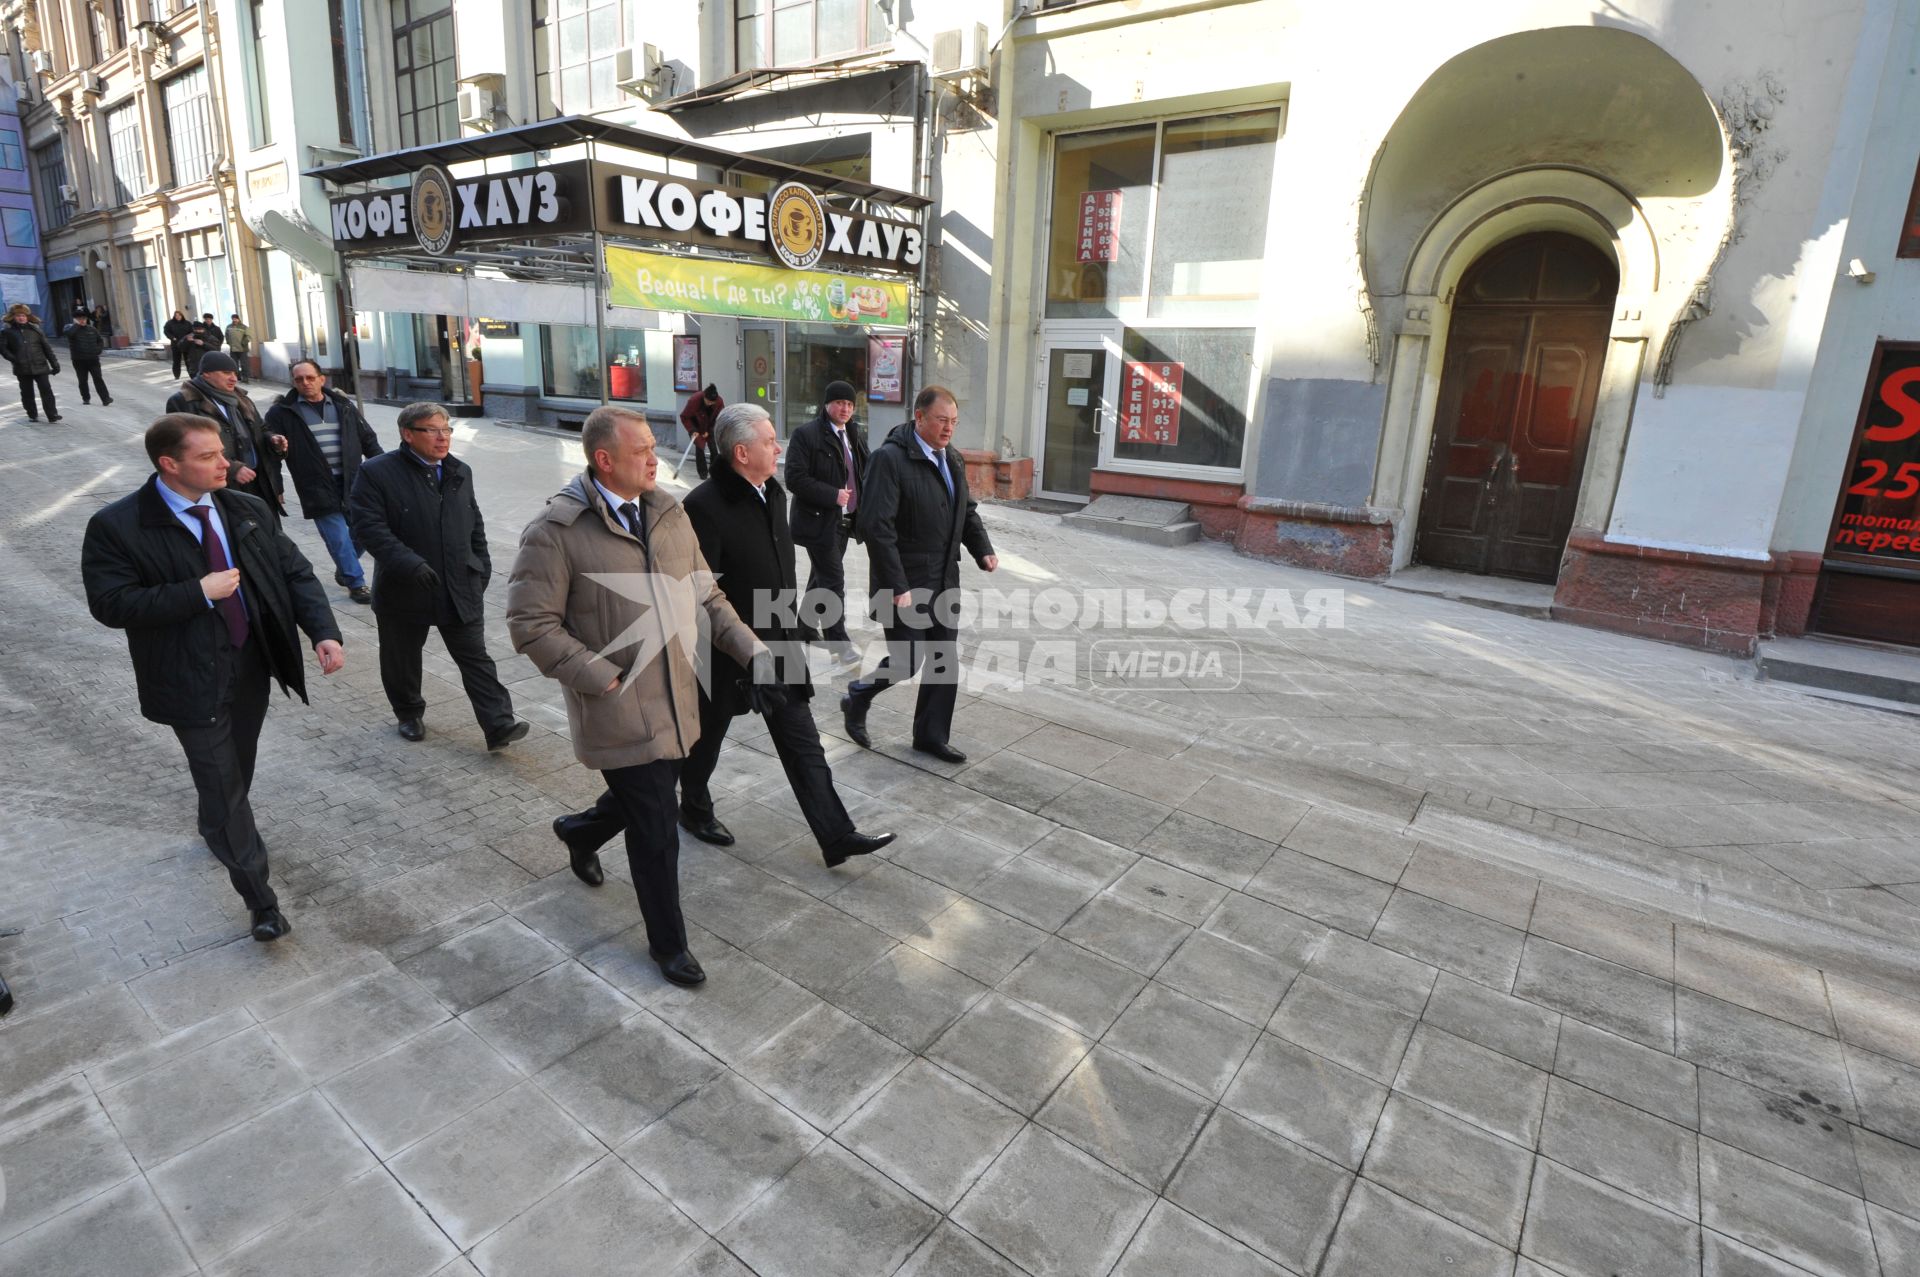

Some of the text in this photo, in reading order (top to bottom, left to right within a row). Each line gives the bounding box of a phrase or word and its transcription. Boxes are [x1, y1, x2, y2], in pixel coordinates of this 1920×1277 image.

[332, 194, 408, 241] КОФЕ
[456, 171, 559, 229] ХАУЗ
[620, 175, 922, 264] КОФЕ ХАУЗ
[1081, 194, 1096, 260] АРЕНДА
[1099, 236, 1113, 245] 85
[780, 245, 819, 265] КОФЕ ХАУЗ
[1099, 249, 1111, 258] 15
[637, 268, 788, 305] Весна! Где ты?
[1162, 366, 1170, 376] 8
[1153, 382, 1176, 393] 926
[1127, 365, 1145, 440] АРЕНДА
[1152, 399, 1175, 409] 912
[1154, 415, 1170, 425] 85
[1154, 431, 1169, 440] 15
